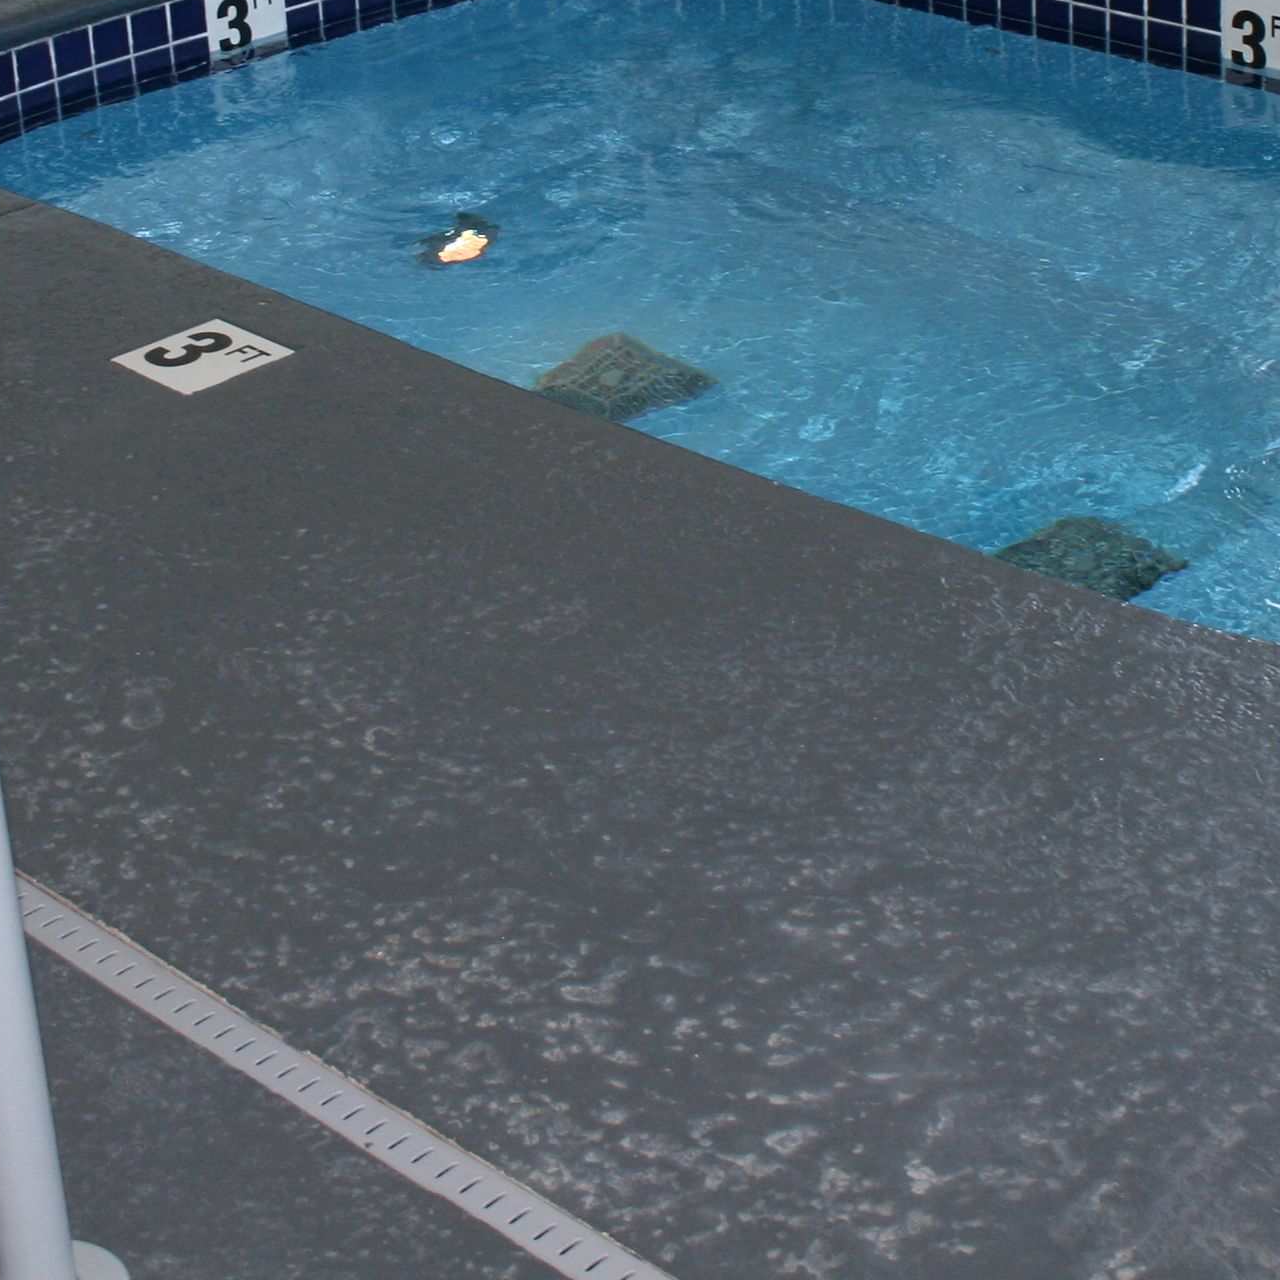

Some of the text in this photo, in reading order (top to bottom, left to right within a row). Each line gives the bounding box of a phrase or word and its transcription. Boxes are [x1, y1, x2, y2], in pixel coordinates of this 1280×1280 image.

[1231, 9, 1267, 70] 3
[143, 331, 272, 367] 3 FT
